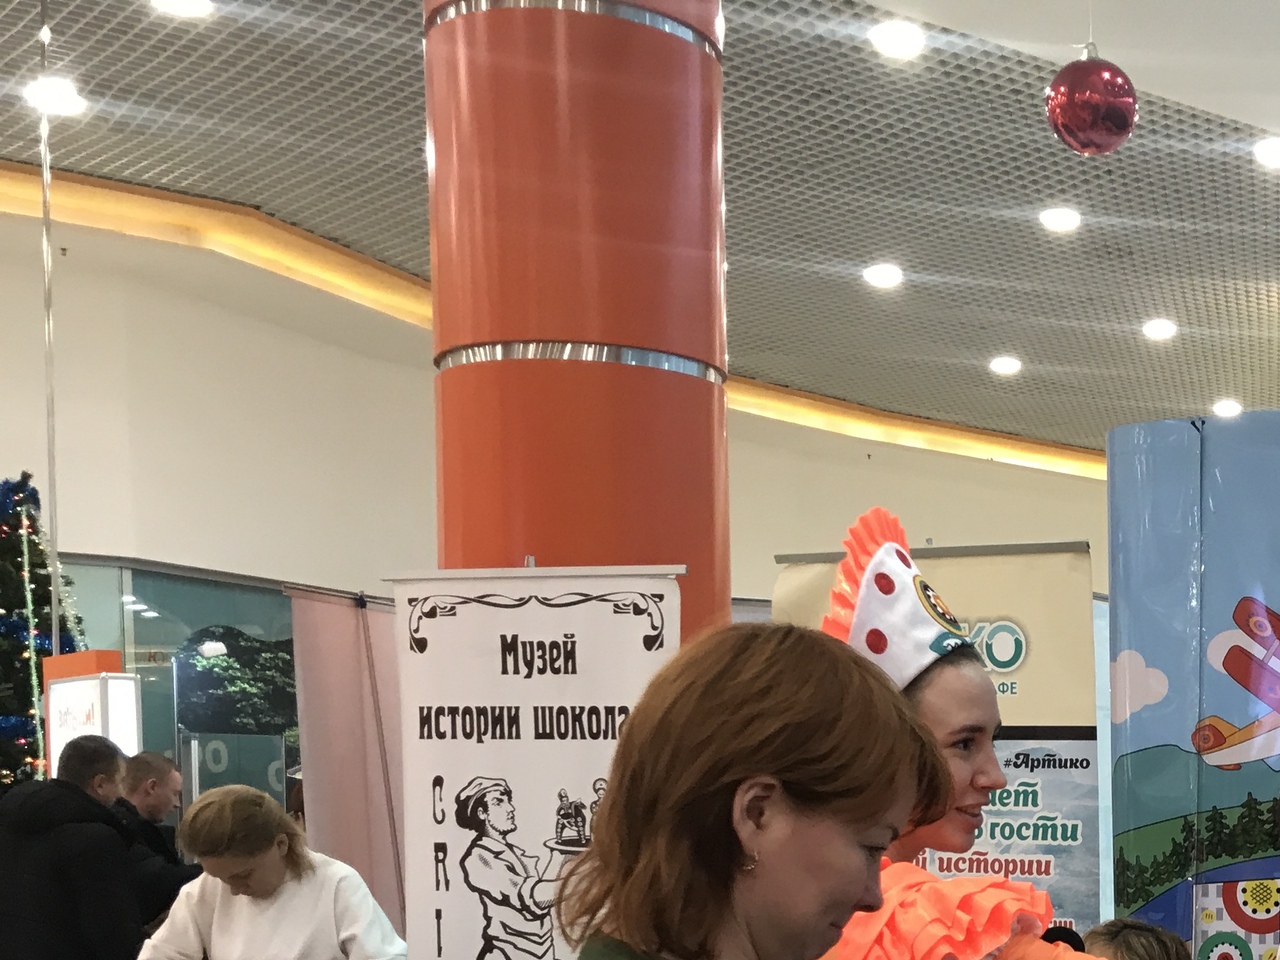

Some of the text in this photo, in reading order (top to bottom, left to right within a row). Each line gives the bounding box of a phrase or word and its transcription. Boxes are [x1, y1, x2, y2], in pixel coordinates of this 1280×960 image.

[500, 633, 577, 679] Музей
[418, 705, 521, 744] истории
[1003, 752, 1091, 773] #Артико
[989, 815, 1080, 842] гости
[937, 851, 1052, 878] истории
